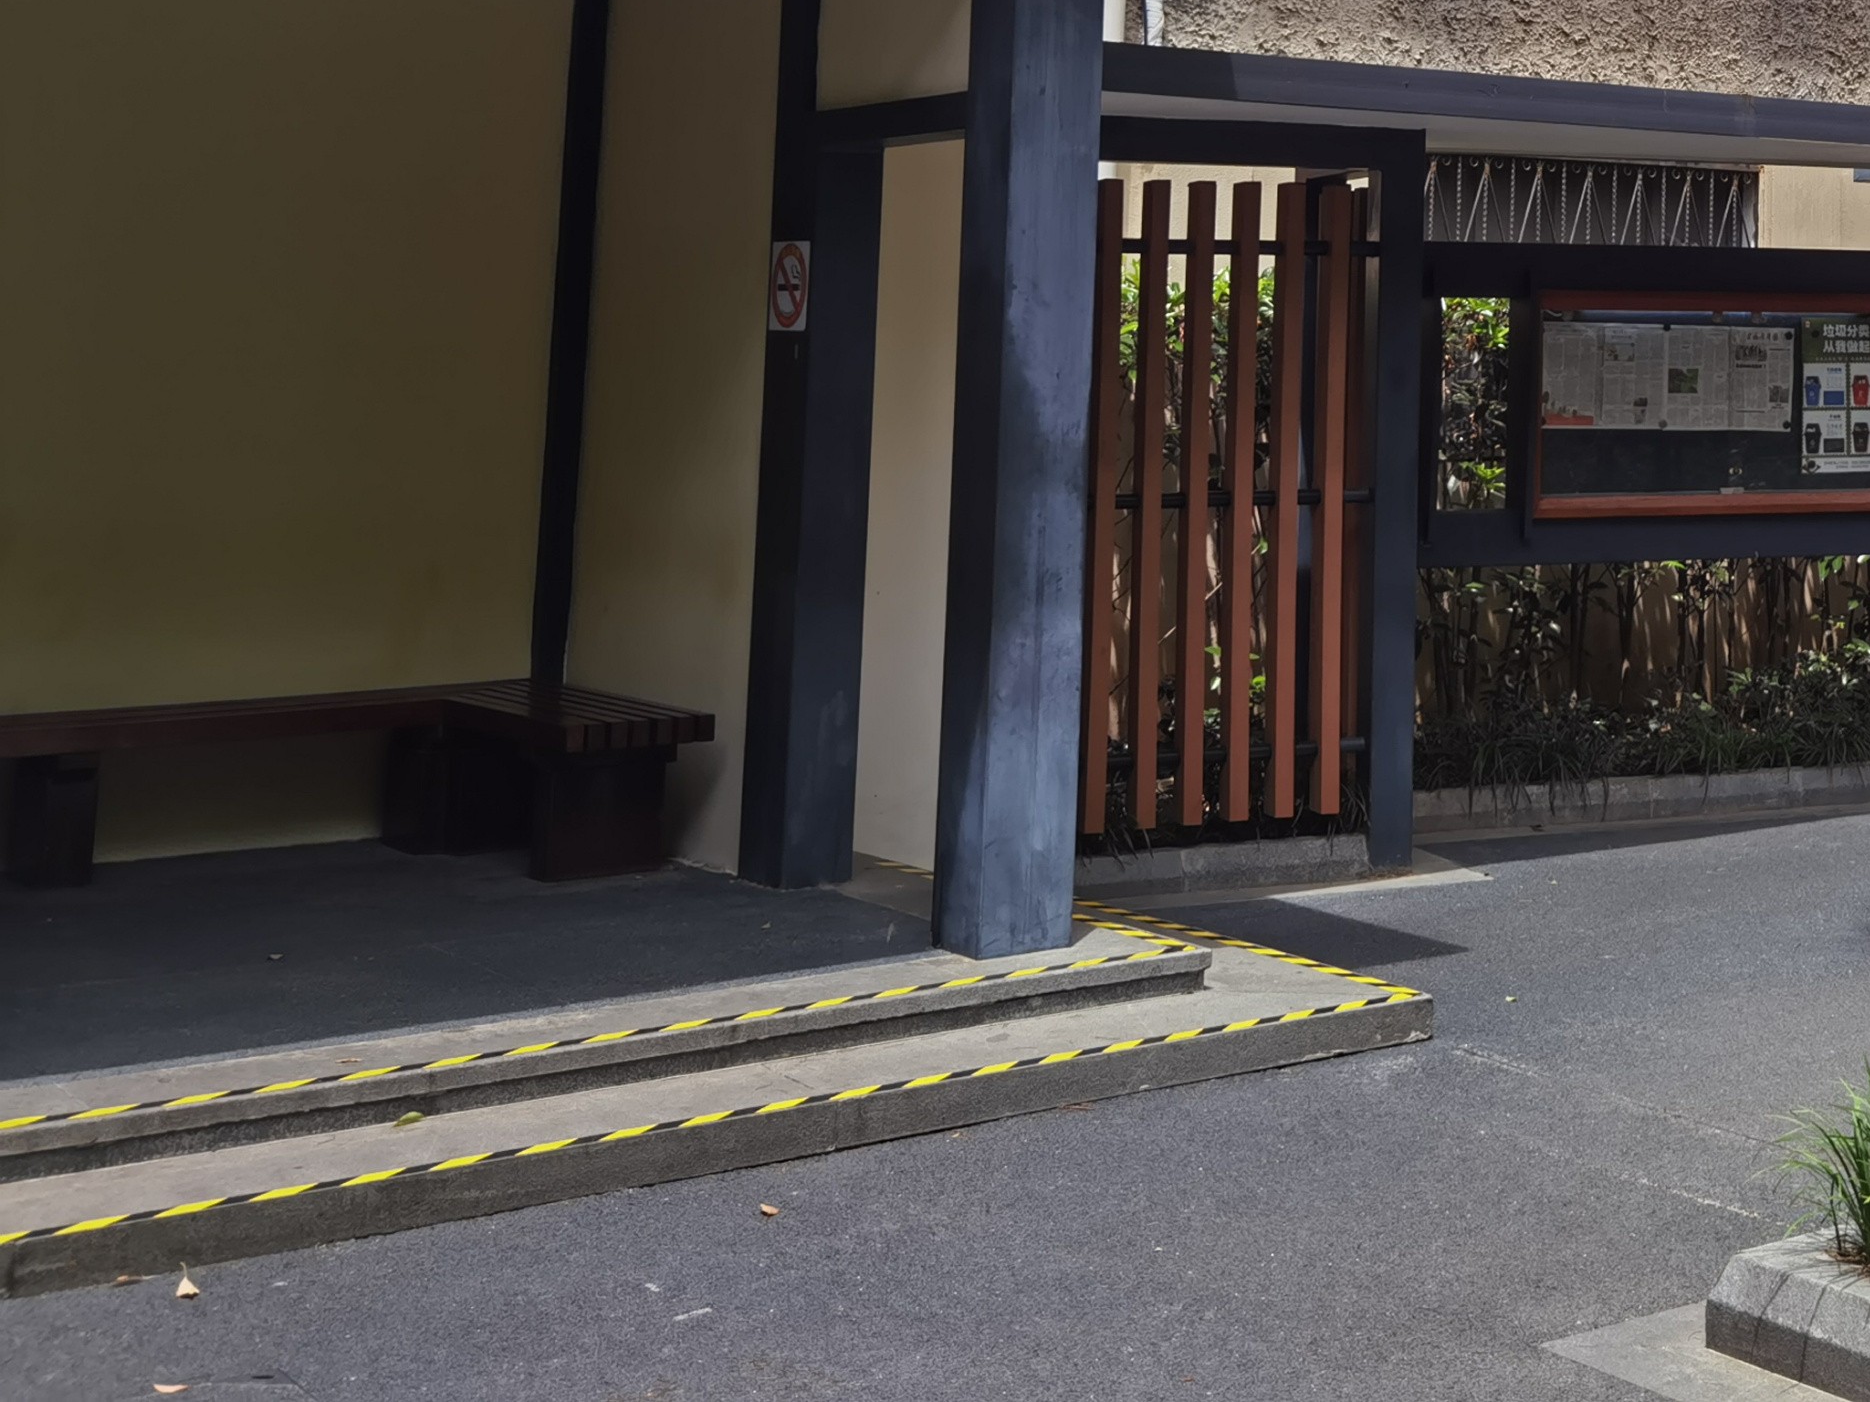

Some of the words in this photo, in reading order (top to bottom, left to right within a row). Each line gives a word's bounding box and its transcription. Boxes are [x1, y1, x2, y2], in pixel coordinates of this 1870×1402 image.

[1823, 324, 1870, 338] 垃圾分类
[1823, 340, 1870, 354] 从我做起
